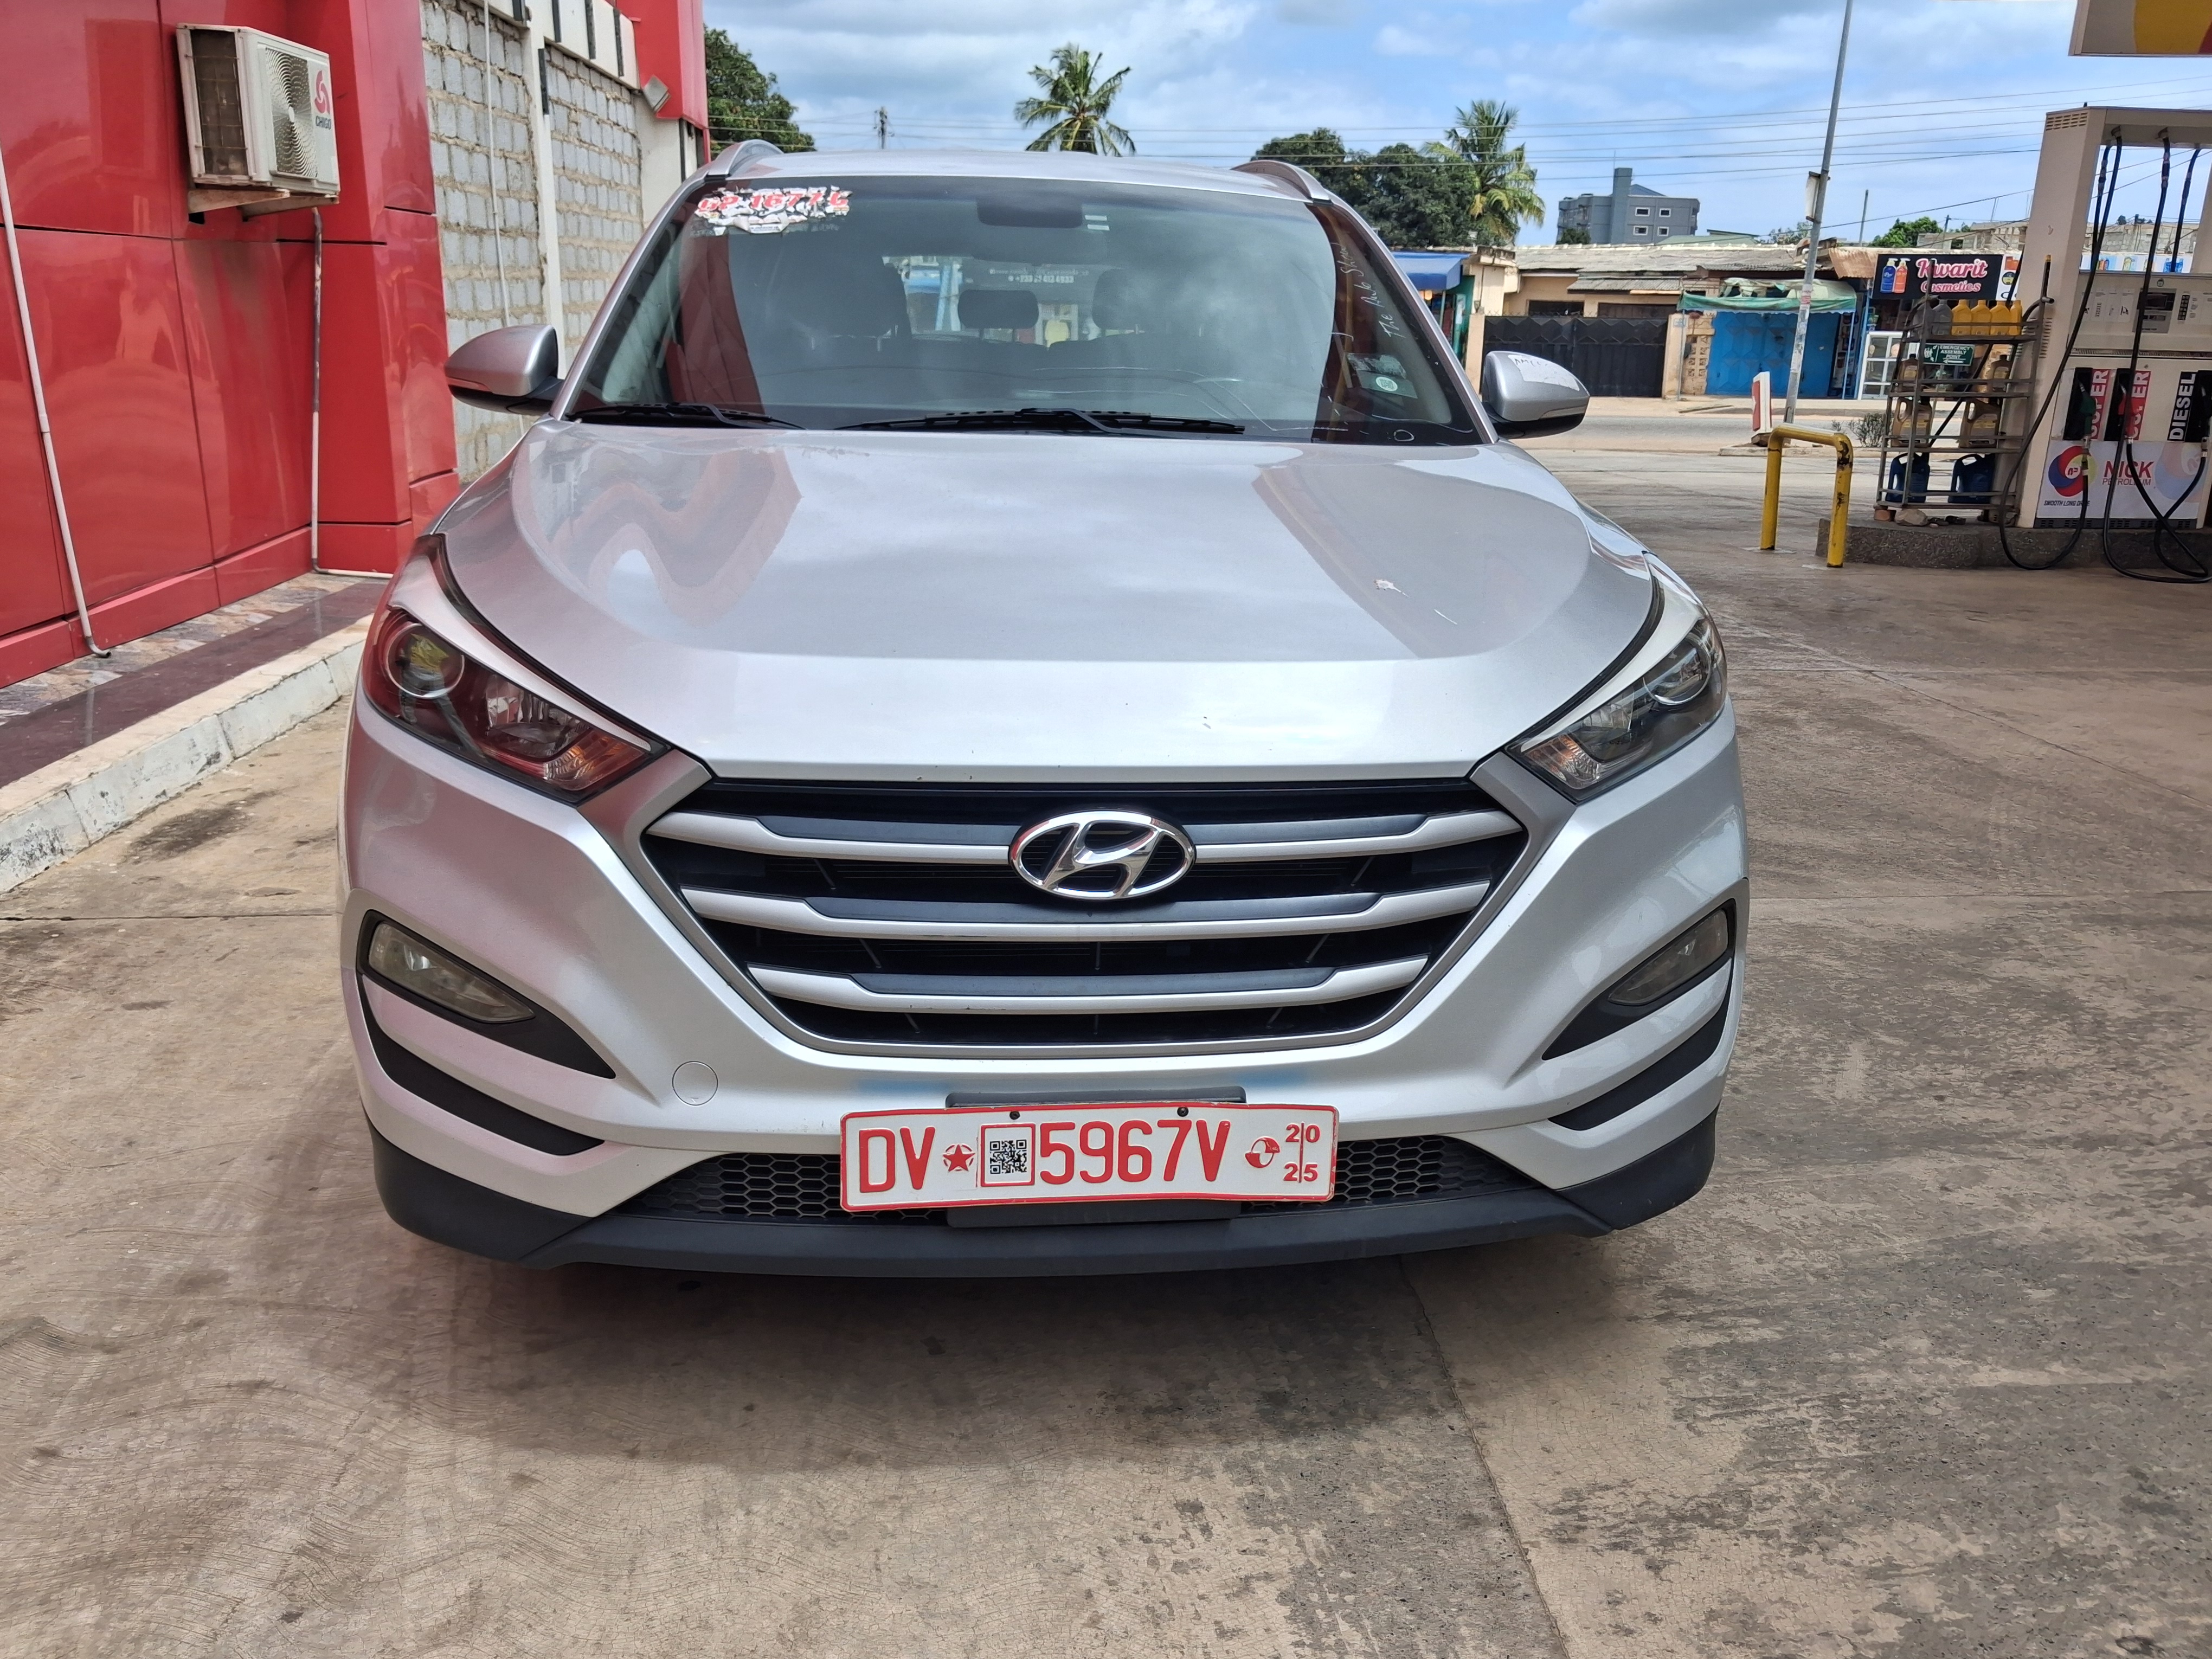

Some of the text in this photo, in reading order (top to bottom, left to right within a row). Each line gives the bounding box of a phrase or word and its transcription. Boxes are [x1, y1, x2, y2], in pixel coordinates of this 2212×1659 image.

[2169, 373, 2196, 440] DIESEL
[2104, 460, 2155, 478] NICK
[858, 1118, 1232, 1194] DV 5967V
